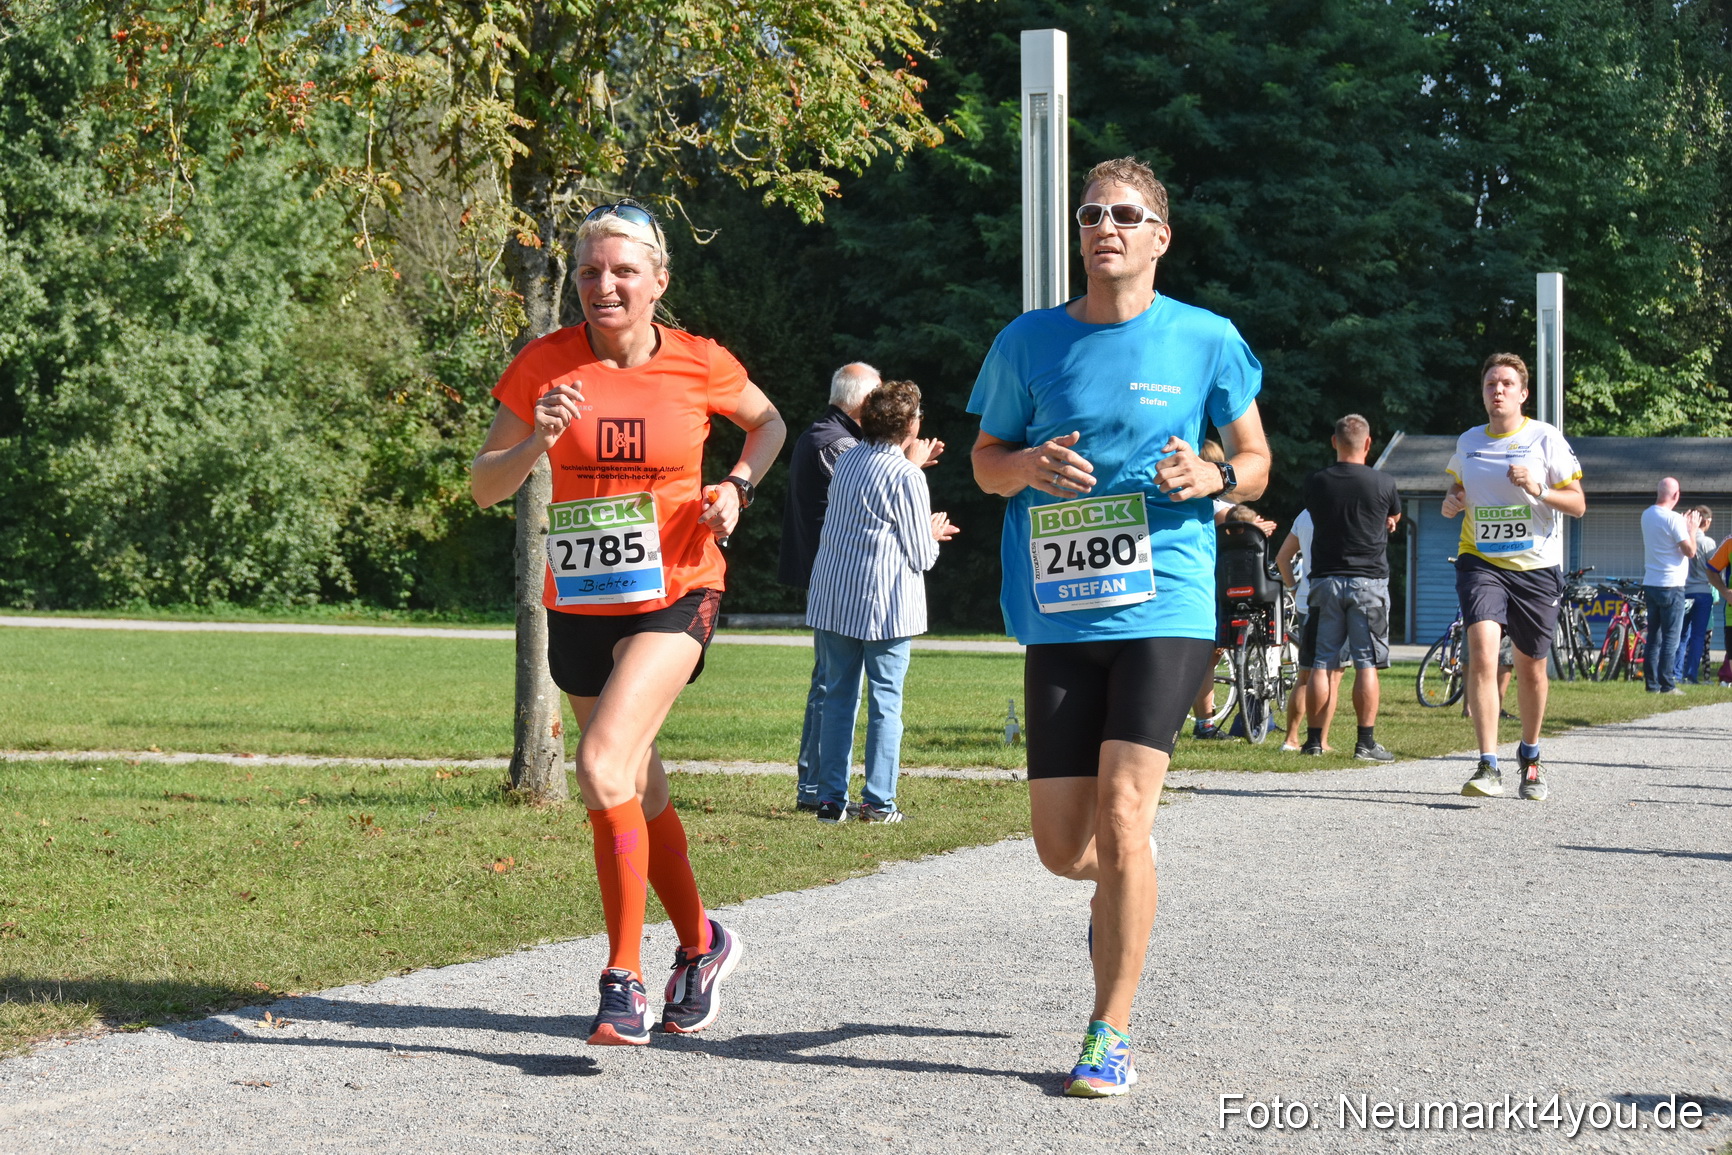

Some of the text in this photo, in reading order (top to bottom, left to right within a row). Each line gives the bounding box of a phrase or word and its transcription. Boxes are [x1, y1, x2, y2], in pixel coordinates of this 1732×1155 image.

[1138, 382, 1182, 394] PFLEIDERER
[1139, 396, 1168, 407] Stefan
[601, 421, 641, 459] D&H
[560, 464, 641, 473] Hochleistungskeramik
[577, 472, 666, 480] www.doebrich-heckel.de
[555, 501, 642, 529] BOCK
[1040, 502, 1131, 532] BOCK
[1478, 507, 1526, 519] BOCK
[1480, 522, 1527, 539] 2739
[556, 531, 645, 570] 2785
[1043, 533, 1137, 575] 2480
[1058, 577, 1127, 599] STEFAN
